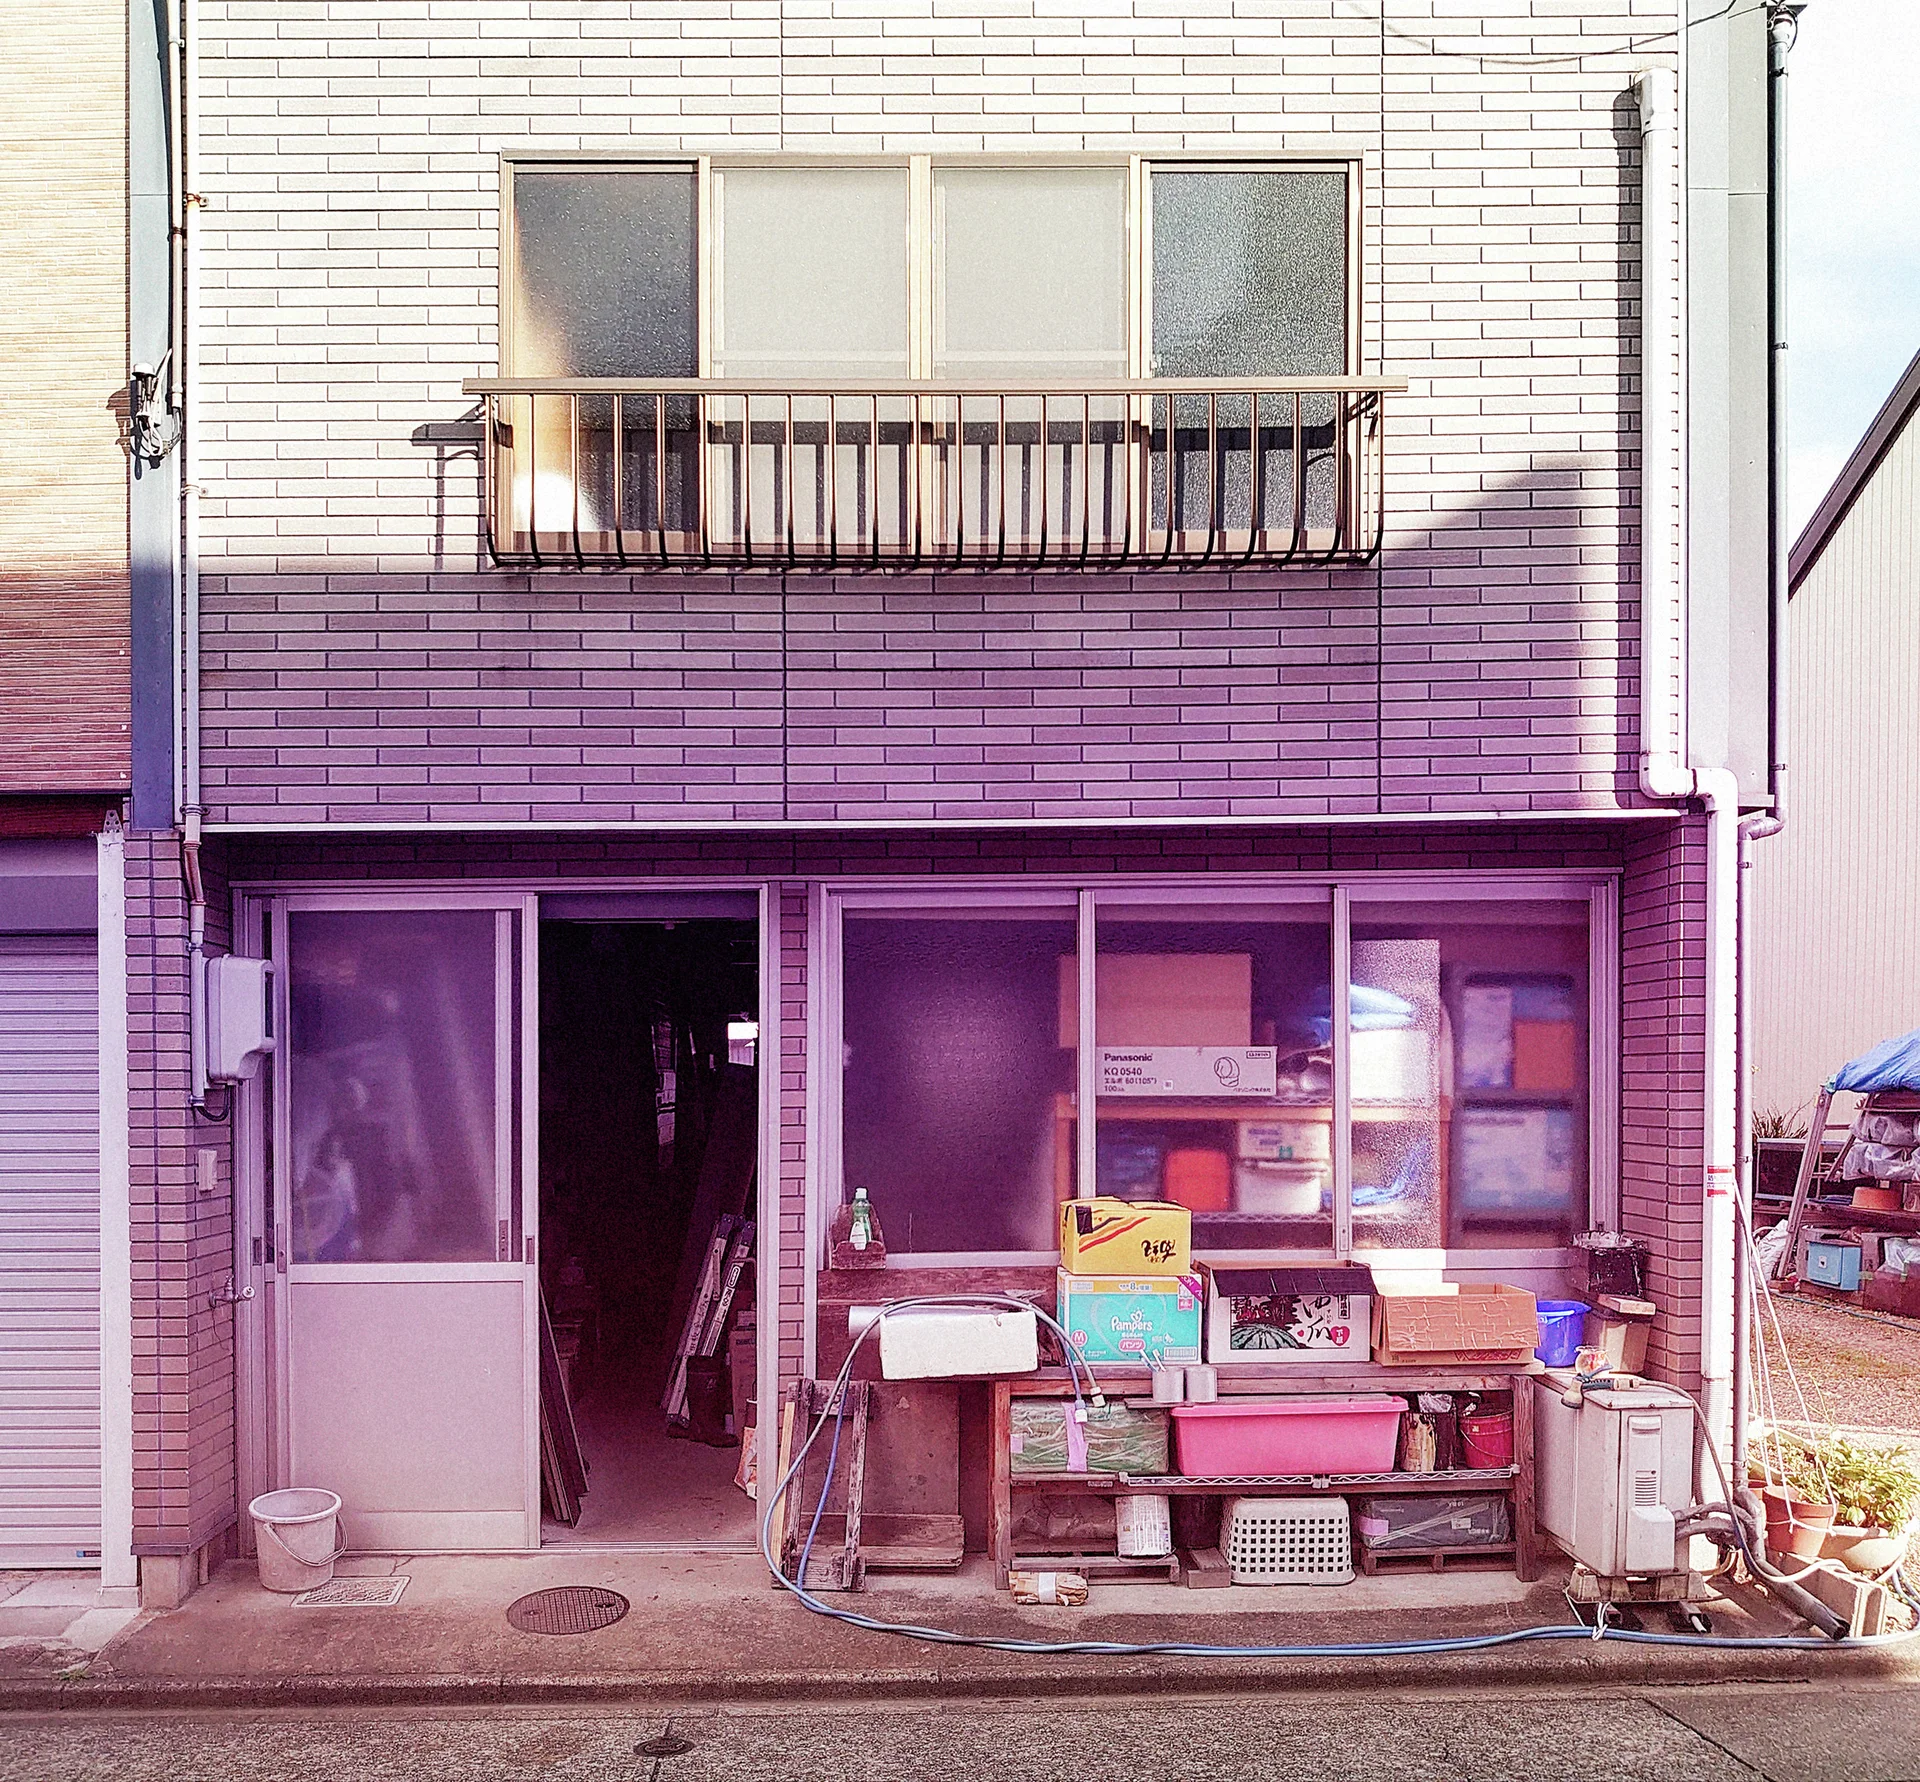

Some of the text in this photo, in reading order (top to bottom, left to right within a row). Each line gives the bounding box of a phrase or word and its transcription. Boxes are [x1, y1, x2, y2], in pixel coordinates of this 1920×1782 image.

[1104, 1053, 1153, 1062] Panasonic
[1111, 1316, 1153, 1333] Pampers
[1121, 1341, 1143, 1349] パンツ
